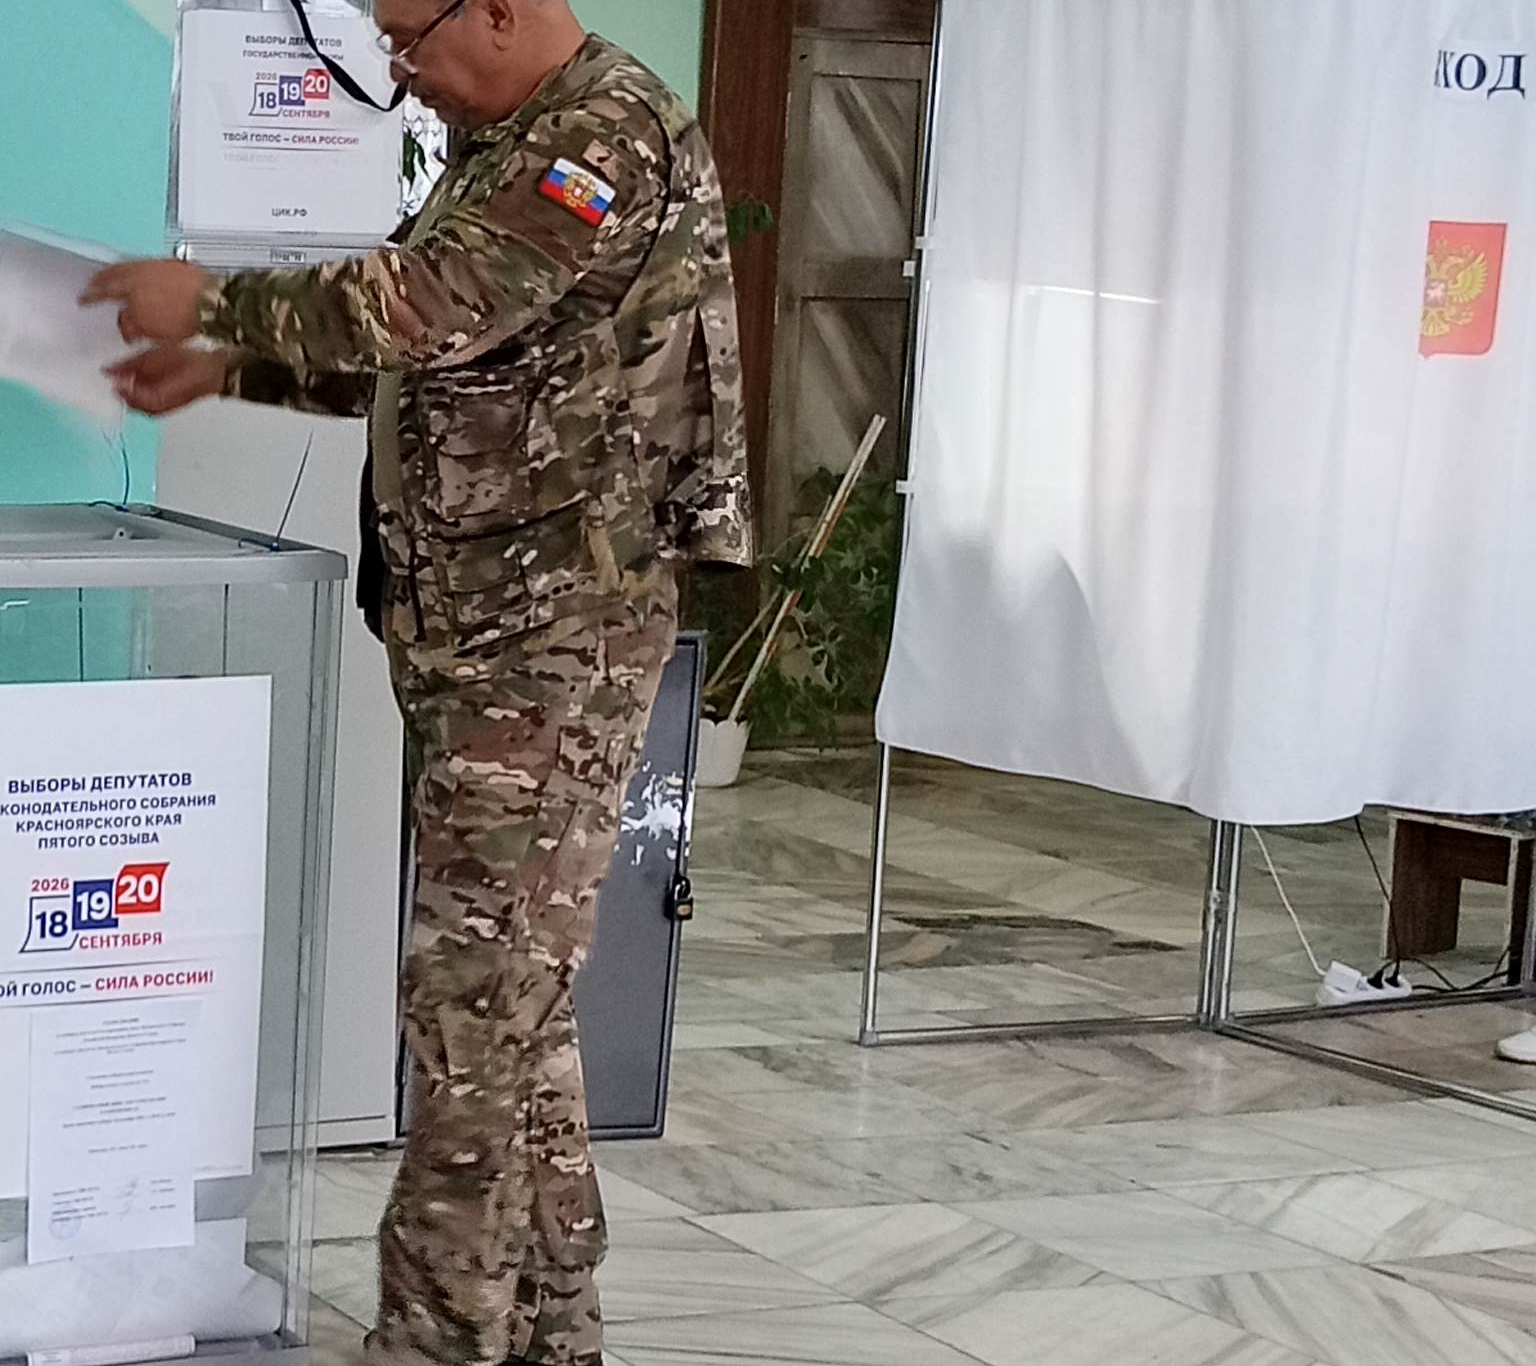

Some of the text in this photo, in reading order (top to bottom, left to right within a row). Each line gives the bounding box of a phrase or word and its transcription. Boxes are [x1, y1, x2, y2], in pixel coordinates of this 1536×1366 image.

[245, 35, 286, 45] ВЫБОРЫ
[281, 82, 300, 101] 19
[304, 75, 328, 93] 20
[258, 92, 276, 109] 18
[282, 109, 330, 118] СЕНТЯБРЯ
[223, 132, 248, 142] ТВОЙ
[250, 134, 281, 143] ГОЛОС
[291, 135, 317, 144] СИЛА
[8, 773, 192, 794] ВЫБОРЫ ДЕПУТАТОВ
[141, 794, 216, 808] СОБРАНИЯ
[16, 814, 182, 833] КРАСНОЯРСКОГО КРАЯ
[38, 832, 159, 849] ПЯТОГО СОЗЫВА
[31, 878, 69, 892] 2026
[118, 873, 159, 905] 20
[77, 890, 110, 921] 19
[35, 910, 68, 939] 18
[79, 932, 162, 949] СЕНТЯБРЯ
[22, 980, 76, 996] ГОЛОС
[95, 977, 138, 991] СИЛА
[143, 970, 214, 987] РОССИИ!
